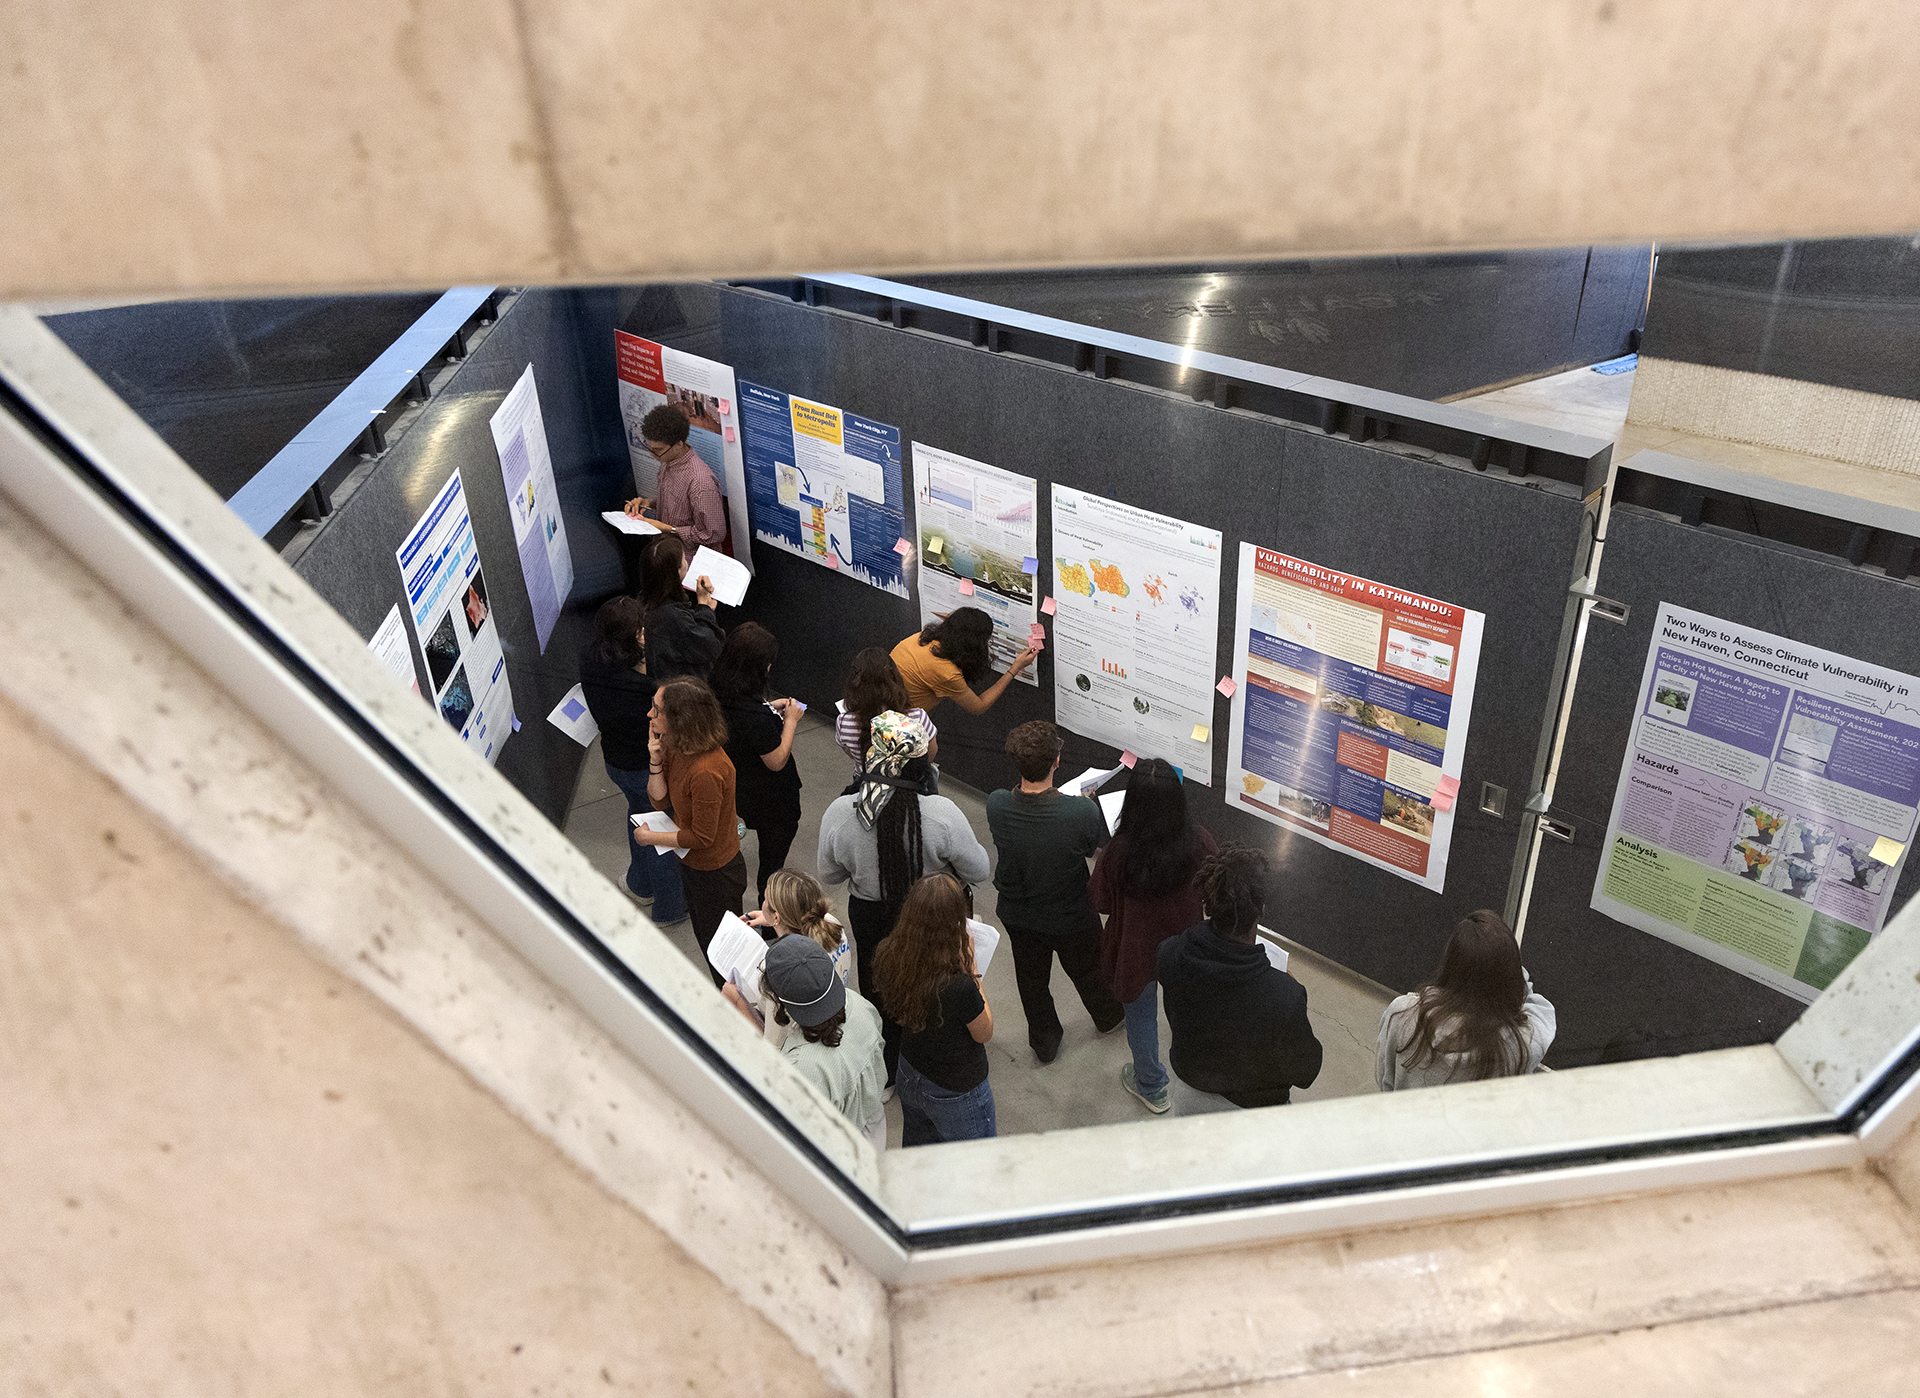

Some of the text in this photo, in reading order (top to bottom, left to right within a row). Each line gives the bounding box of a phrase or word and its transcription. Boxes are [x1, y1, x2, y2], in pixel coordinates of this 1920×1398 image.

[794, 402, 837, 421] From Rust Belt
[796, 410, 803, 418] to
[803, 412, 835, 429] Metropolis
[1155, 516, 1183, 530] Vulnerability
[1257, 561, 1343, 594] HAZARDS, BENEFICIARIES, AND GAPS
[1258, 550, 1347, 587] VULNERABILITY
[1351, 579, 1364, 592] IN
[1368, 584, 1452, 618] KATHMANDU:
[1662, 627, 1809, 680] New Haven, Connecticut
[1665, 614, 1909, 696] Two Ways to Assess Climate Vulnerability in
[1658, 659, 1766, 700] the City of New Haven, 2016
[1660, 651, 1781, 696] Cities in Hot Water: A Report to
[1793, 703, 1845, 727] Vulnerability
[1846, 720, 1900, 744] Assessment,
[1796, 695, 1884, 729] Resilient Connecticut
[1636, 751, 1680, 776] Hazards
[1630, 775, 1672, 798] Comparison
[1616, 834, 1658, 862] Analysis
[1821, 917, 1853, 937] Sources
